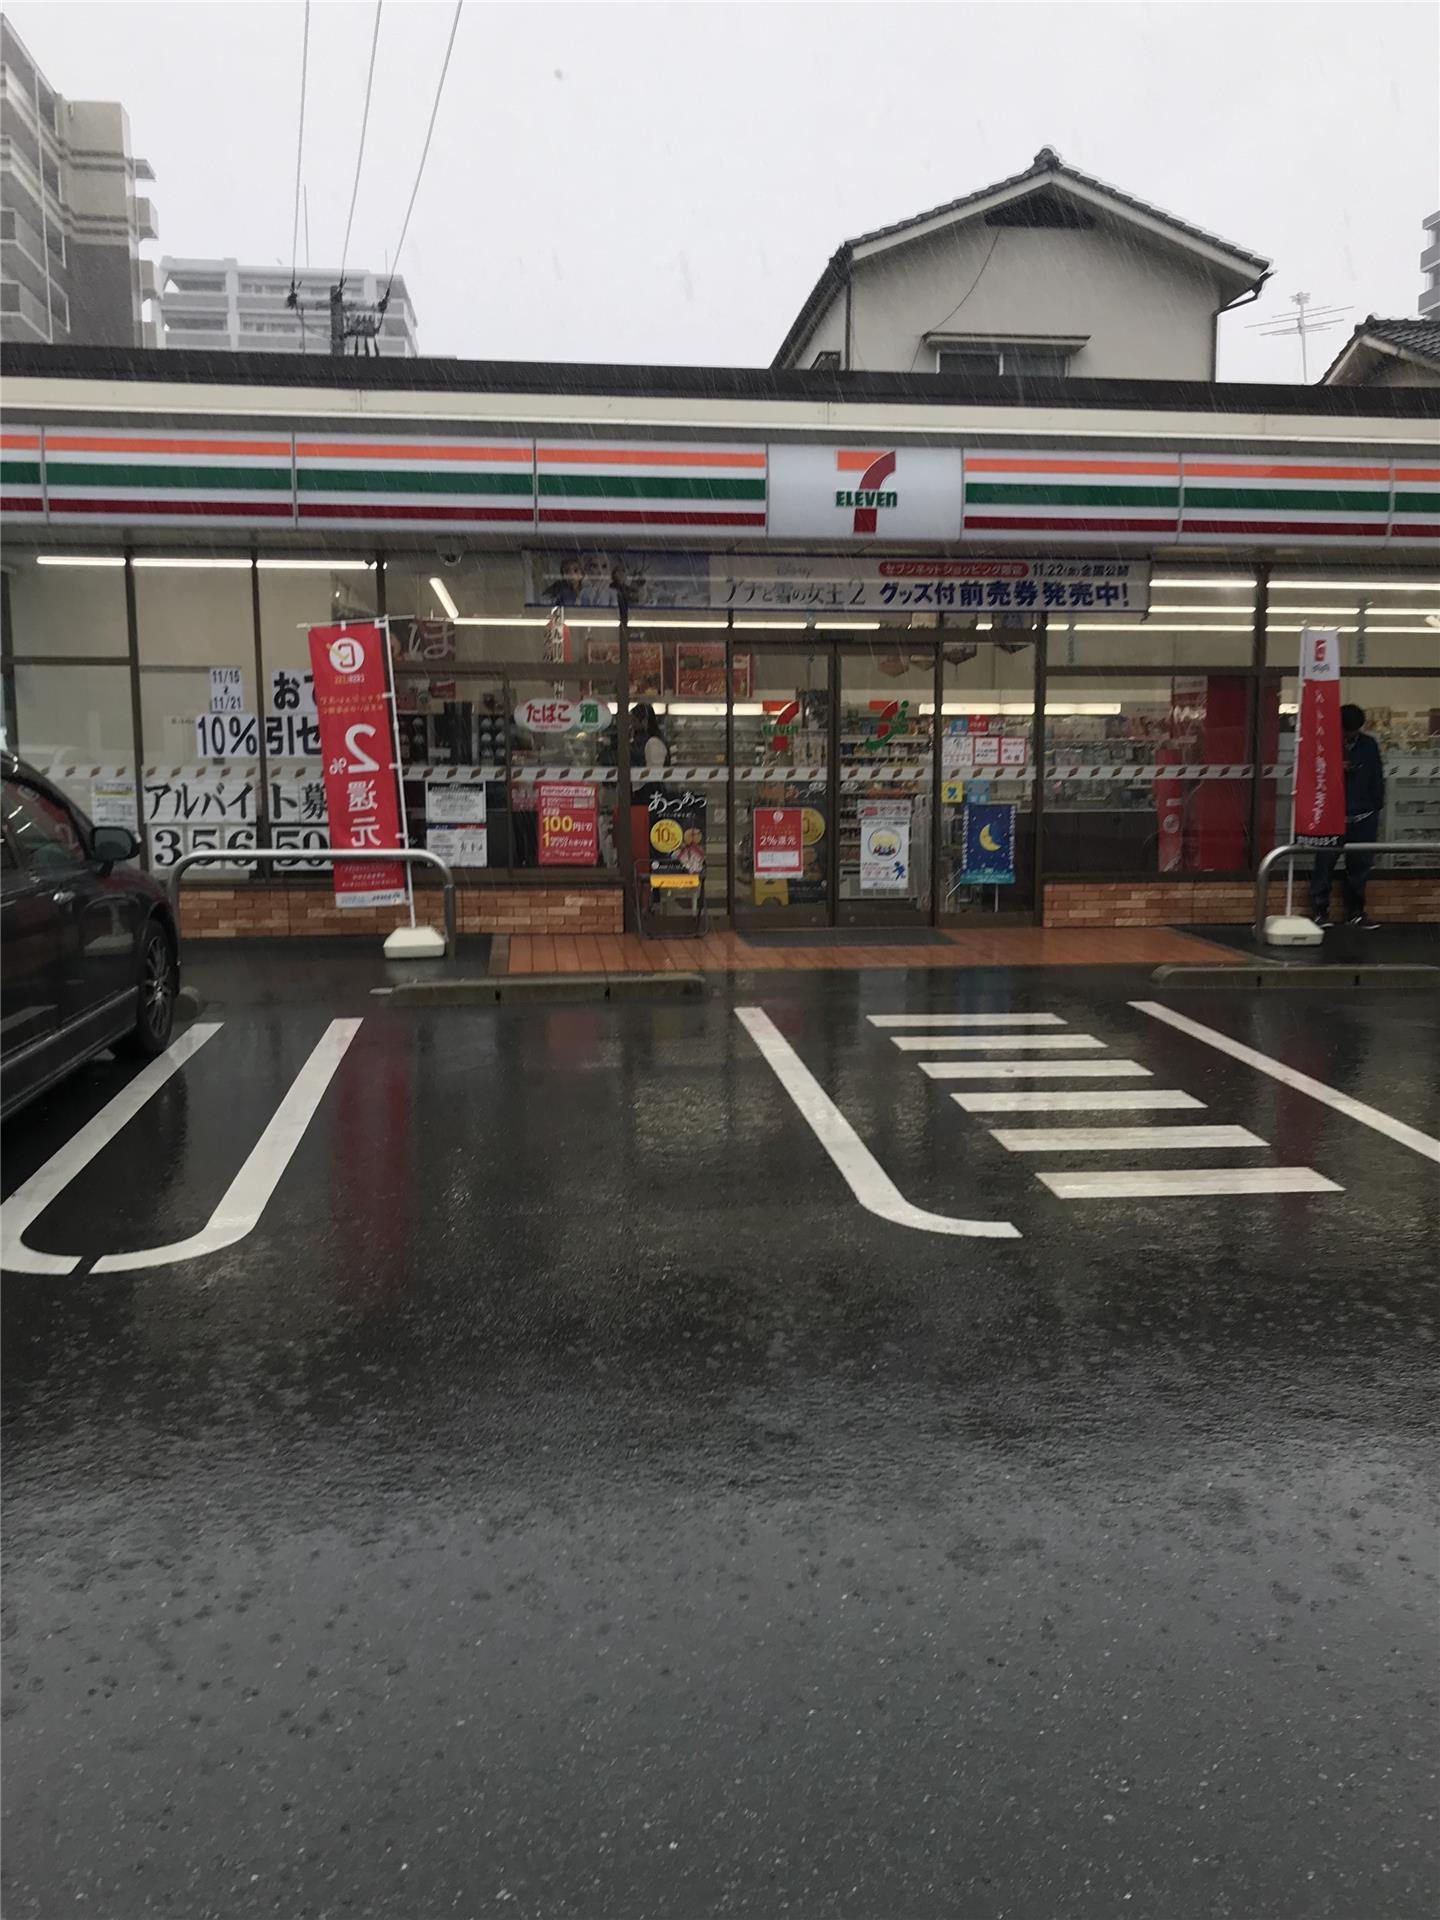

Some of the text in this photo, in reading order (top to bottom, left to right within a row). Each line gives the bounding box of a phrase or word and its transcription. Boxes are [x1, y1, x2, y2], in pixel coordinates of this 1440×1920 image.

[212, 671, 239, 684] 11/15
[213, 696, 241, 709] 11/21
[526, 703, 571, 722] たばこ
